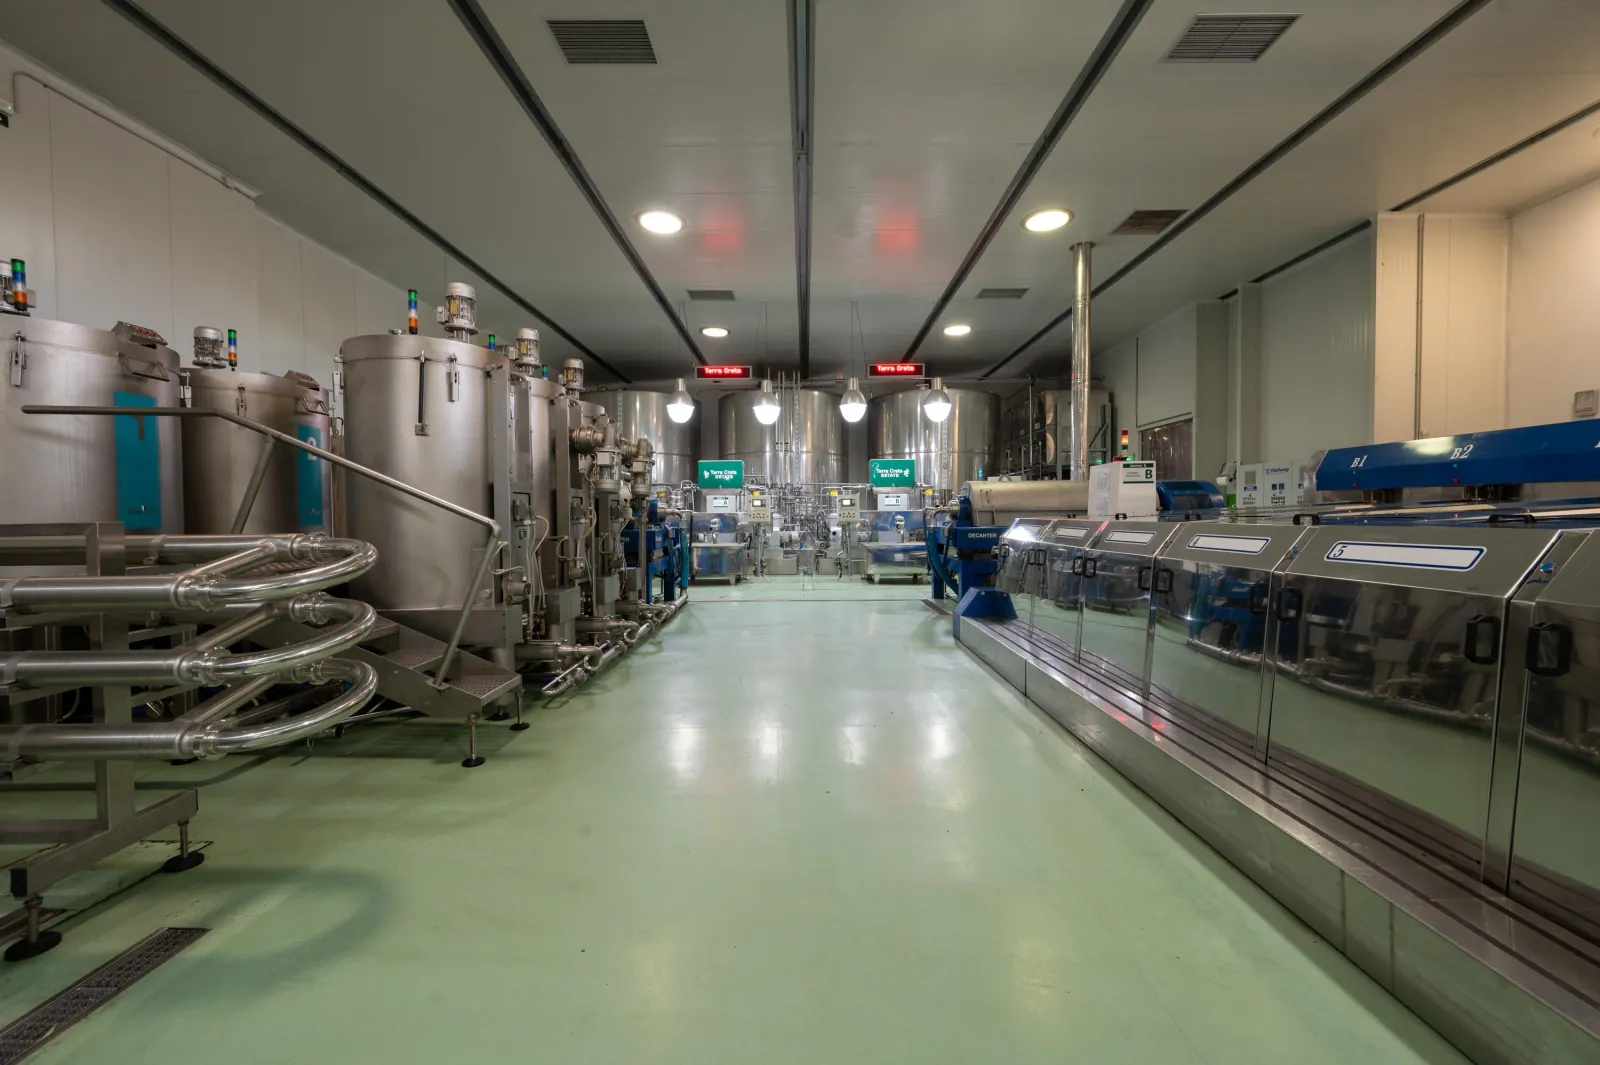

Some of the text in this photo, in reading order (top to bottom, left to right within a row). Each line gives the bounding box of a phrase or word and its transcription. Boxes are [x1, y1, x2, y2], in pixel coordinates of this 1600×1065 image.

[1449, 443, 1474, 460] B2
[1350, 454, 1368, 468] B1
[1145, 469, 1153, 479] B
[1333, 545, 1348, 558] 5
